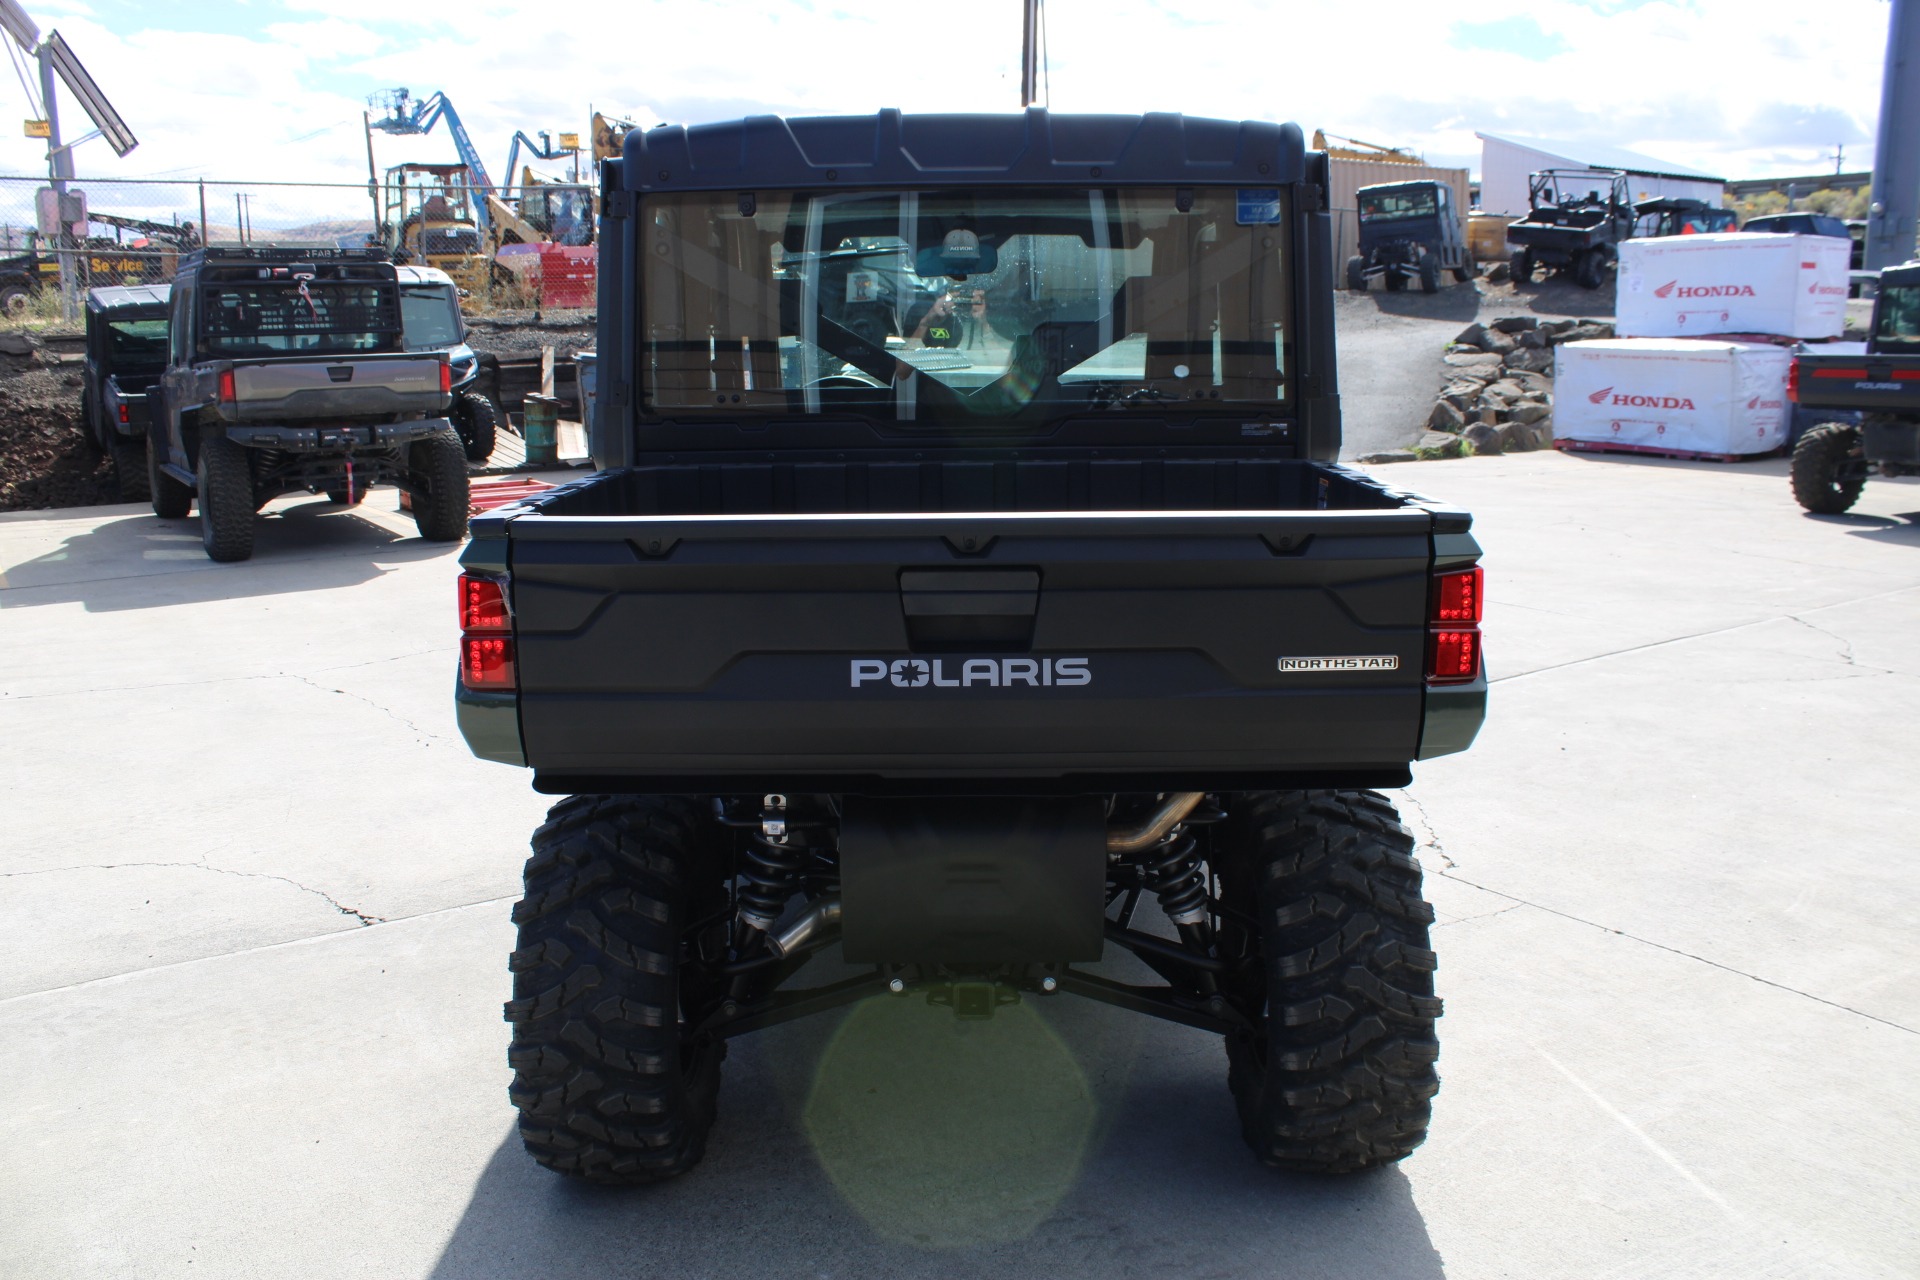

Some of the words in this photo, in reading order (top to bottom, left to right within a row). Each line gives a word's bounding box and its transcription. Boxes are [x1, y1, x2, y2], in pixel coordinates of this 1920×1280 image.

[445, 229, 457, 238] CAT
[91, 258, 144, 273] Sevice
[1676, 285, 1756, 298] HONDA
[1855, 382, 1902, 390] POLARIS
[1612, 394, 1695, 410] HONDA
[1283, 657, 1394, 669] NORTHSTAR
[850, 657, 1092, 688] POLARIS
